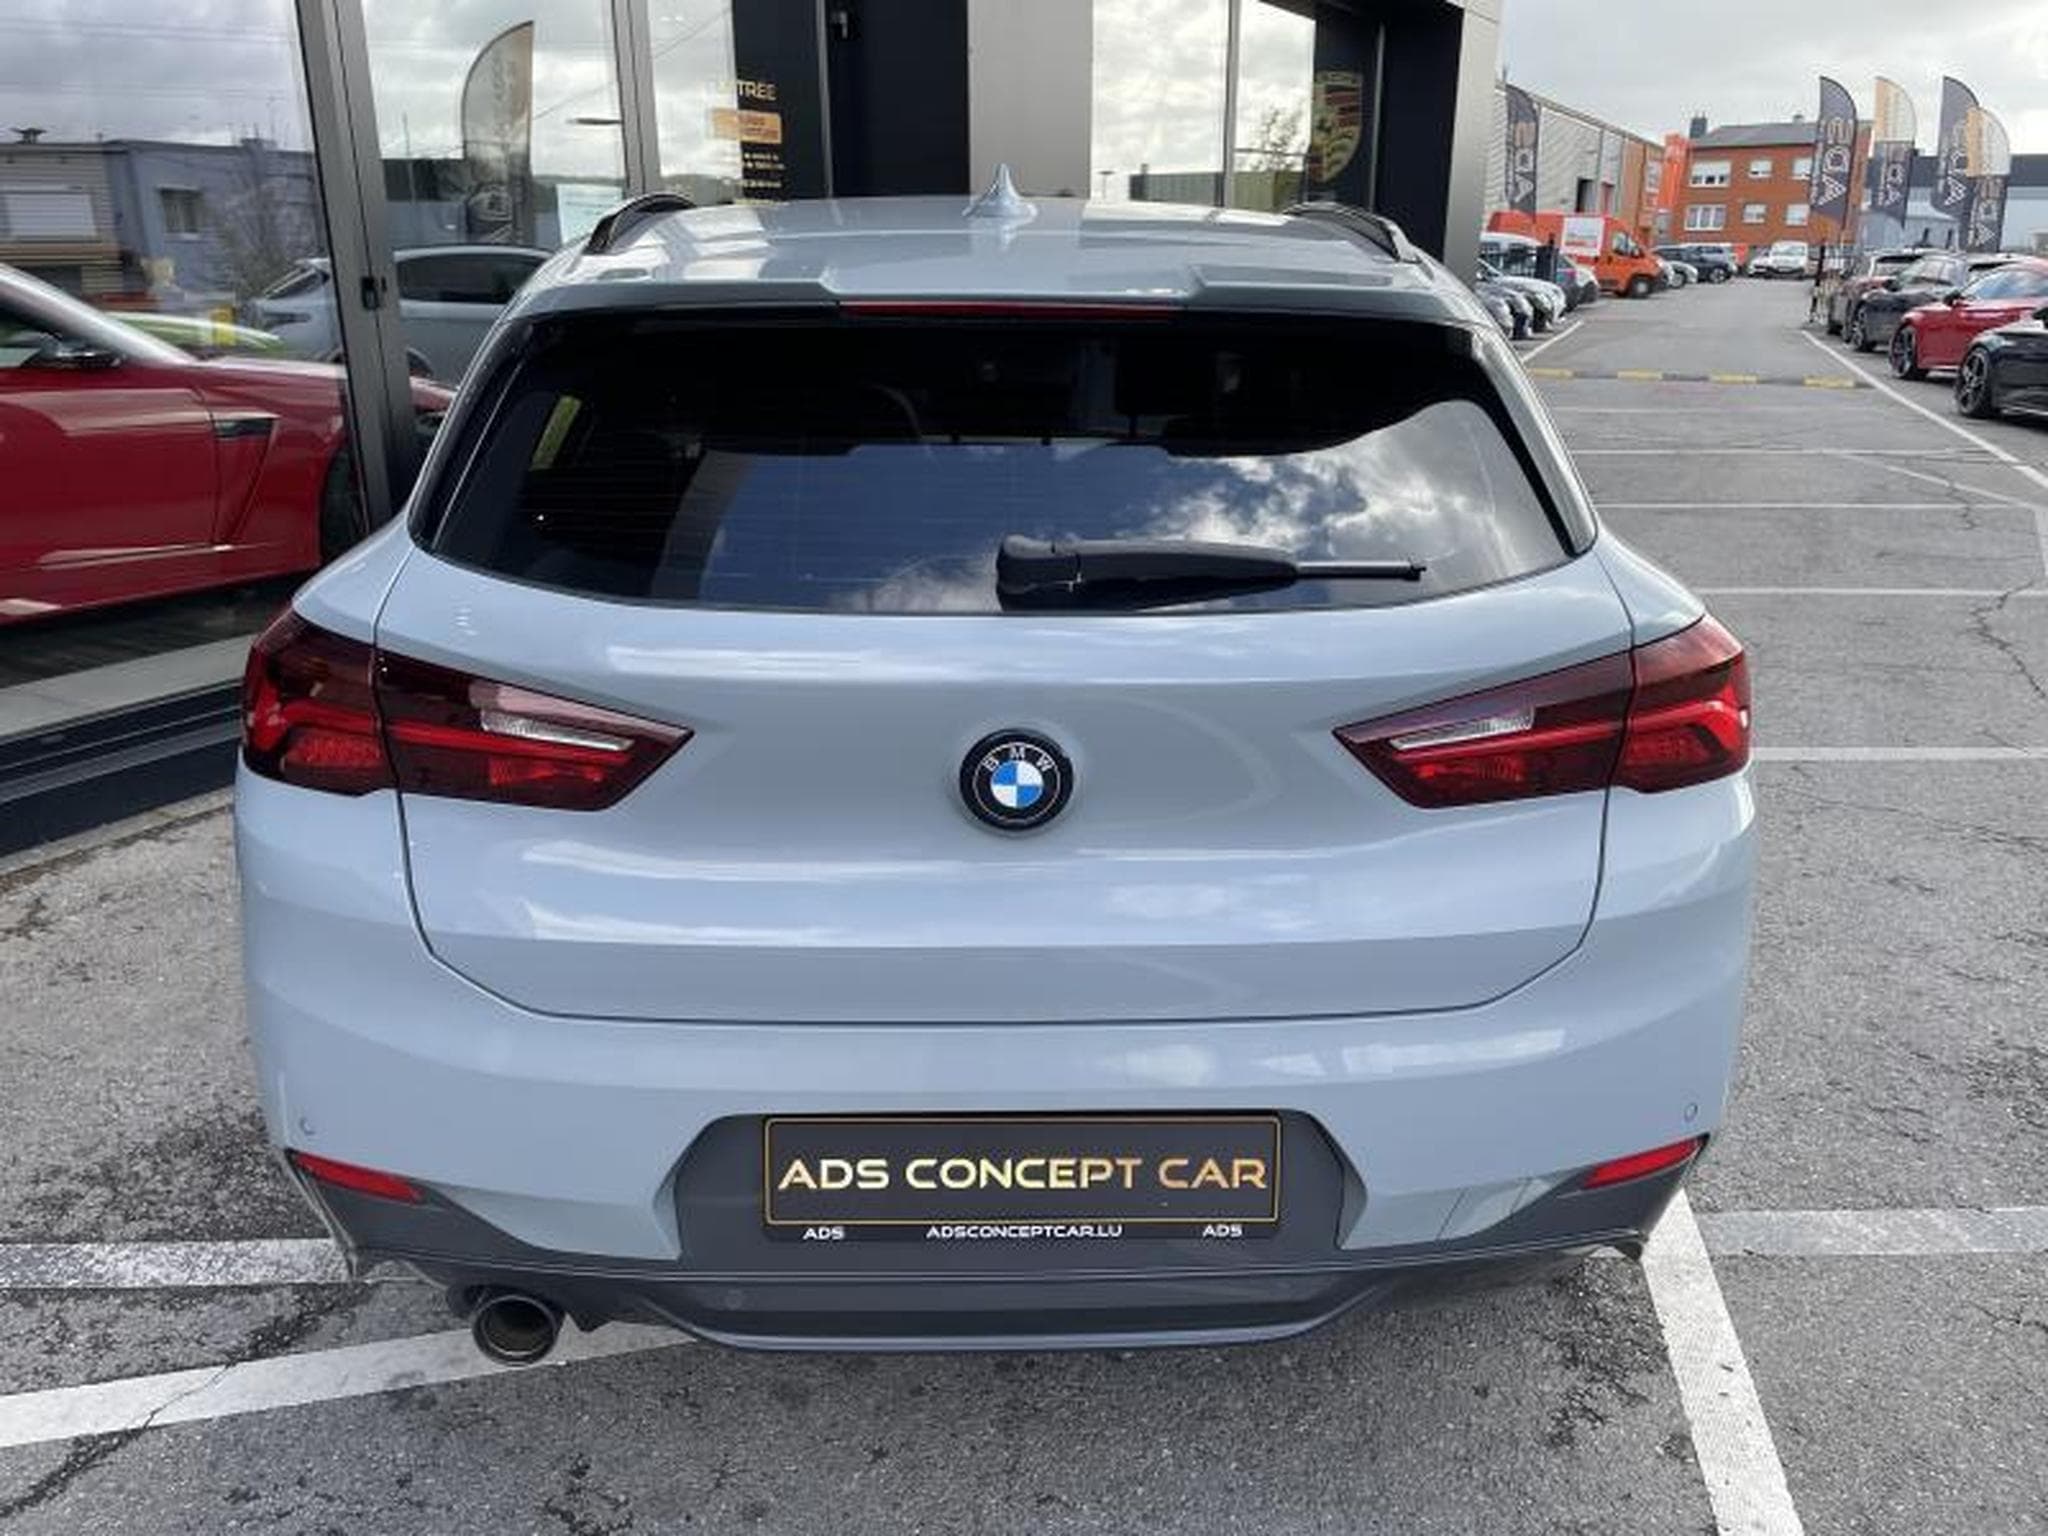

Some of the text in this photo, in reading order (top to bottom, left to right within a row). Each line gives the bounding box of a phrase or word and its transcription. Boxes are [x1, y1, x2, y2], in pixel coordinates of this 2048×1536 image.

[981, 746, 1054, 771] BMW
[778, 1157, 1268, 1190] ADS CONCEPT CAR
[803, 1224, 1243, 1240] ADS ADSCONCEPTCAR.LU ADS
